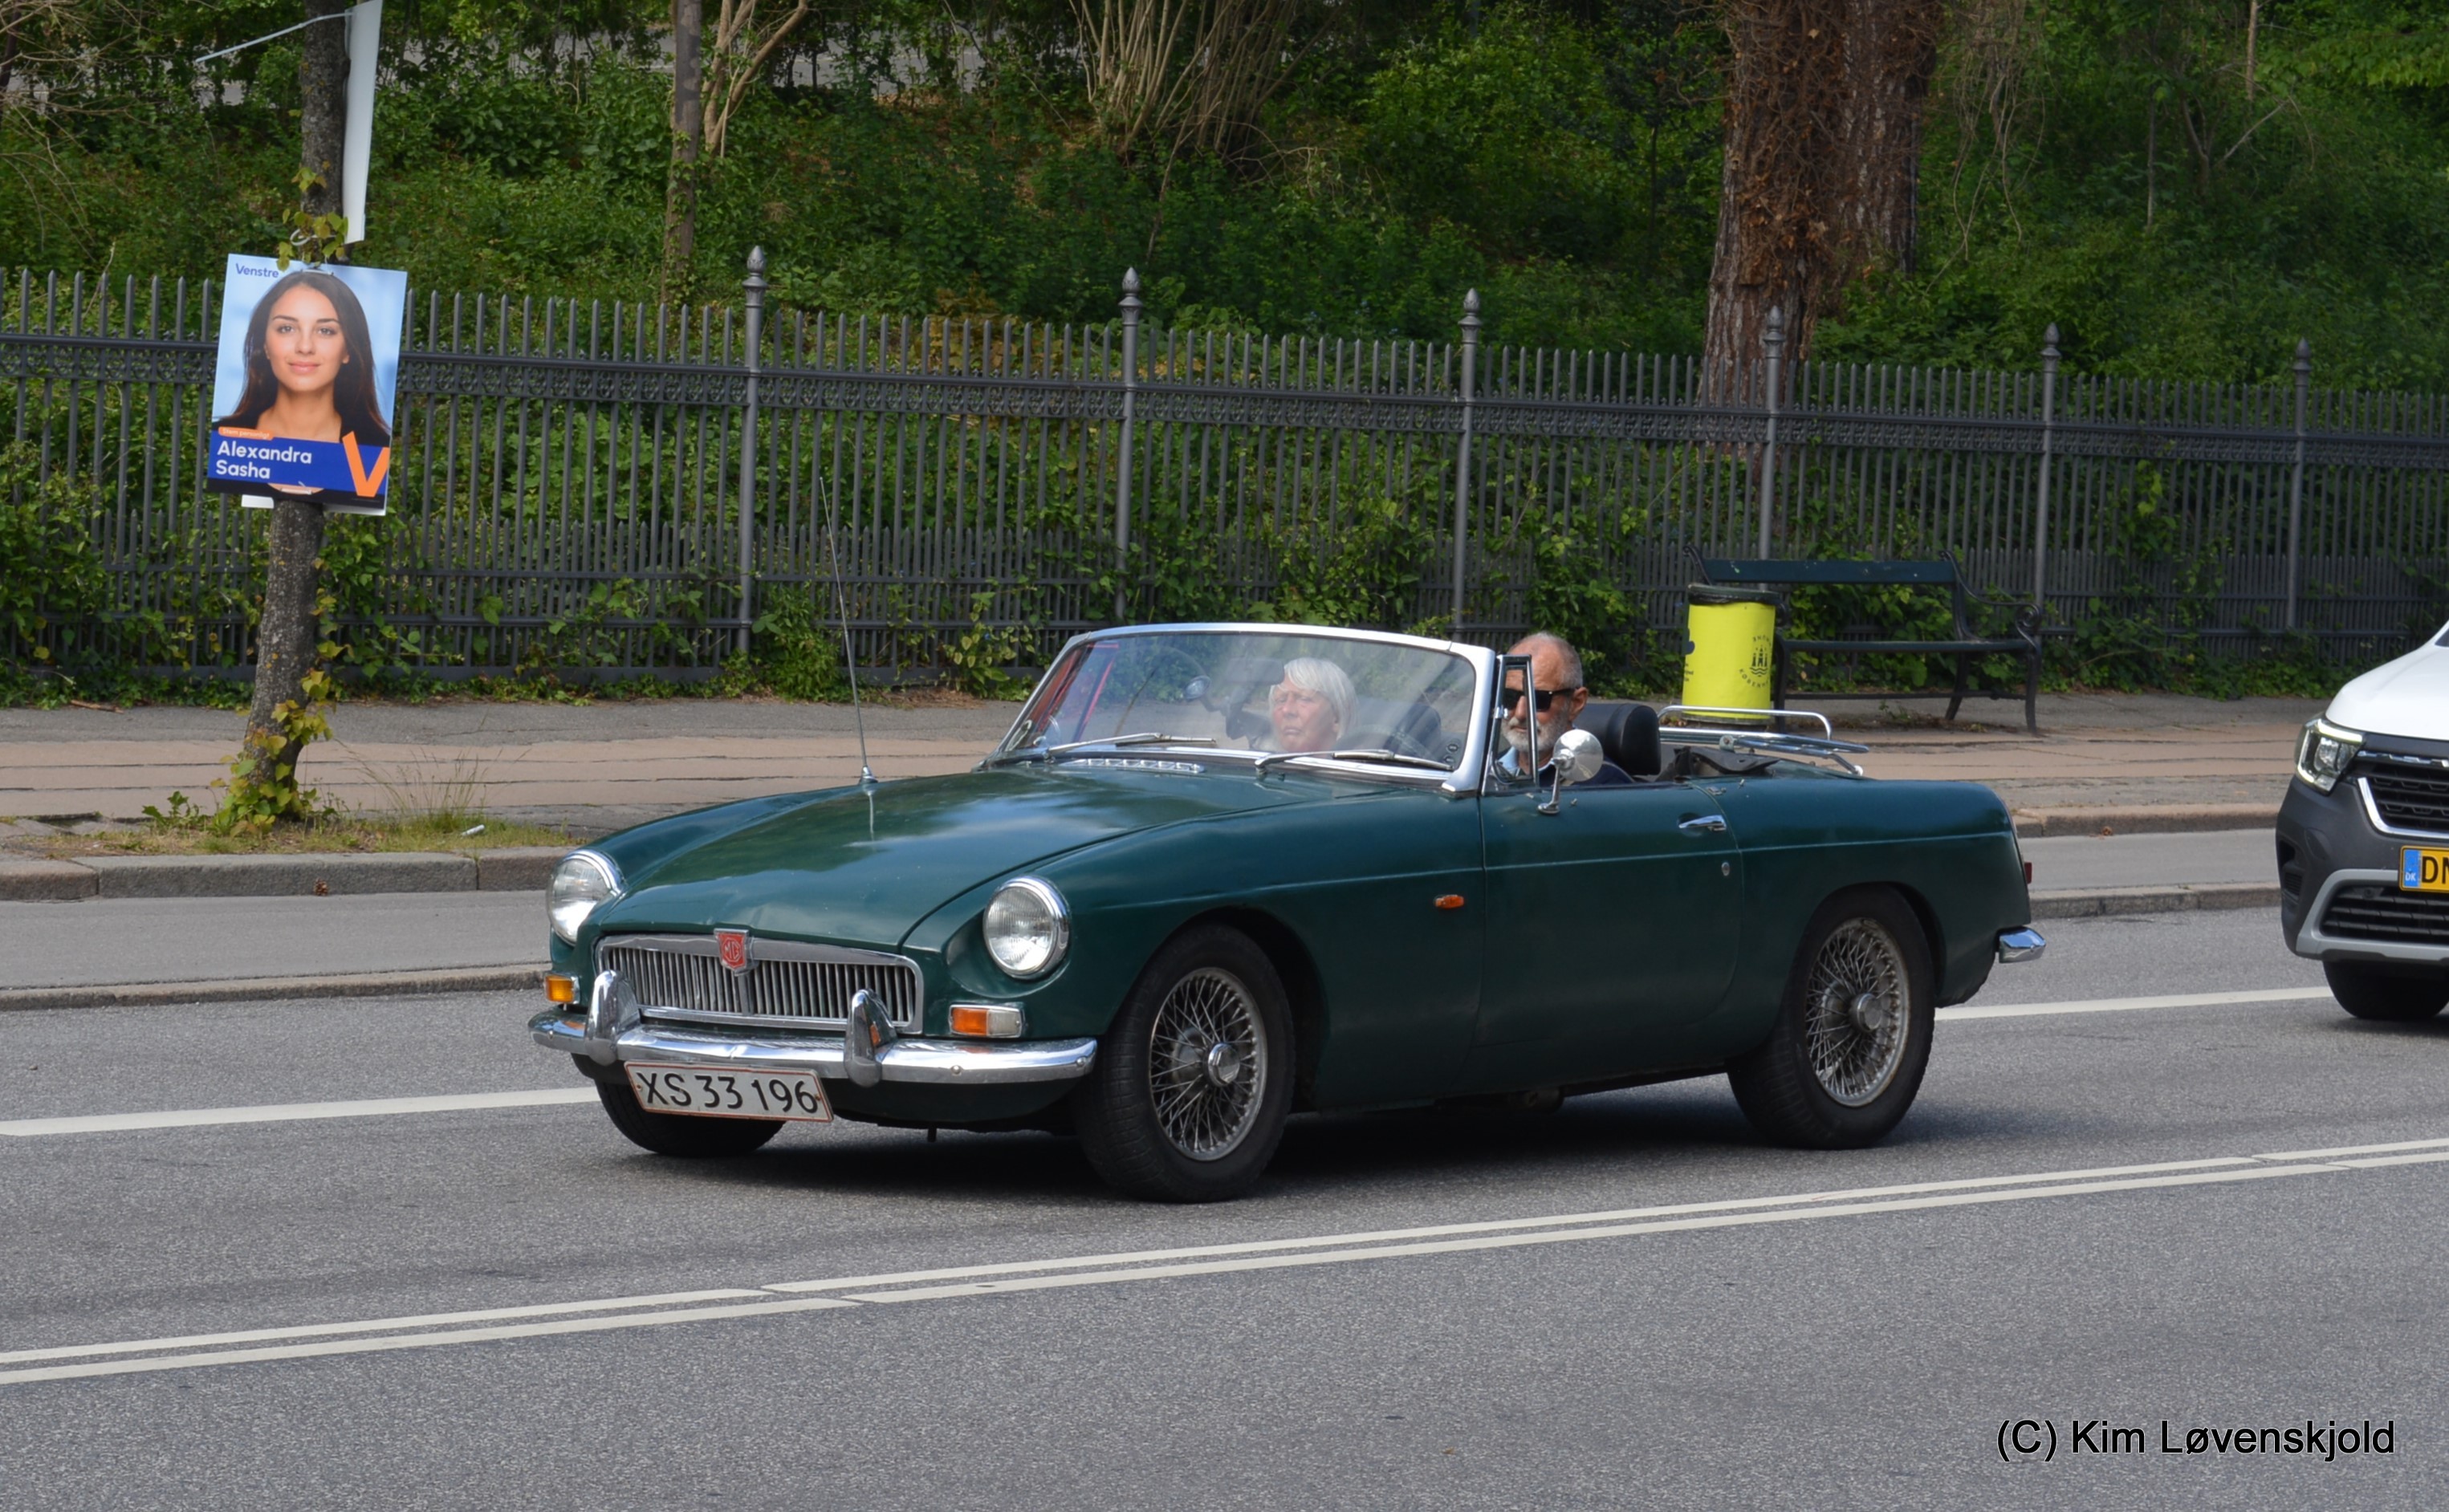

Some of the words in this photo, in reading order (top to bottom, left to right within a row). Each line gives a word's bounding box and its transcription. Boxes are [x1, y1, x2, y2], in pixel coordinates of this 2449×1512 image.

[235, 262, 279, 278] Venstre
[217, 441, 312, 464] Alexandra
[216, 459, 271, 479] Sasha
[343, 431, 390, 498] V
[2405, 872, 2416, 881] DK
[723, 939, 740, 961] MG
[637, 1072, 692, 1107] XS
[694, 1075, 743, 1110] 33
[751, 1079, 819, 1114] 196
